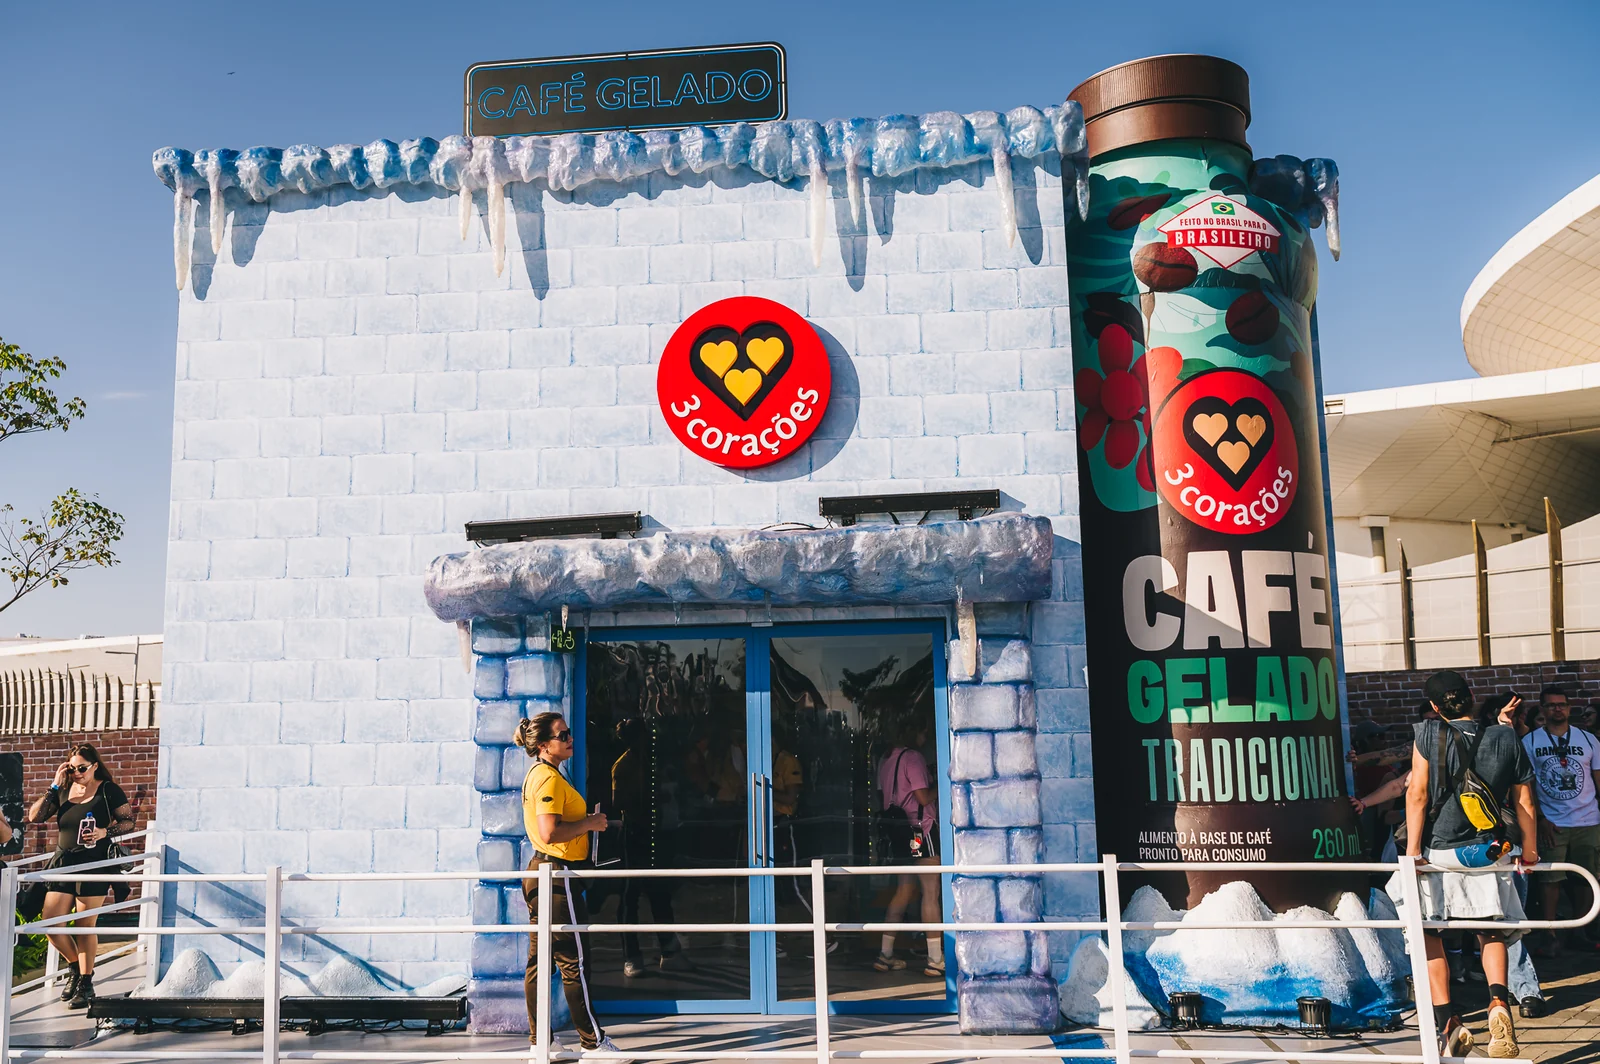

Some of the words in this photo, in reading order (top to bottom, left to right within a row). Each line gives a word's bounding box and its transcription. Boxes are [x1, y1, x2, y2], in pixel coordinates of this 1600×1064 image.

[478, 72, 586, 119] CAFÉ
[596, 68, 772, 110] GELADO
[1175, 230, 1271, 249] BRASILEIRO
[1180, 218, 1201, 227] FEITO
[1203, 218, 1214, 226] NO
[1216, 218, 1242, 227] BRASIL
[1244, 220, 1261, 230] PARA
[1262, 223, 1267, 231] O
[671, 394, 702, 418] 3
[686, 387, 820, 457] corações
[1164, 463, 1195, 486] 3
[1180, 466, 1293, 527] corações
[1122, 531, 1332, 652] CAFÉ
[1127, 656, 1336, 724] GELADO
[1535, 746, 1584, 758] RAMNES
[1142, 736, 1339, 802] TRADICIONAL
[1138, 831, 1187, 845] ALIMENTO
[1189, 829, 1197, 845] À
[1200, 831, 1228, 845] BASE
[1230, 831, 1244, 845] DE
[1246, 828, 1273, 845] CAFÉ
[1312, 827, 1345, 859] 260
[1139, 847, 1179, 861] PRONTO
[1181, 848, 1210, 862] PARA
[1212, 848, 1267, 862] CONSUMO
